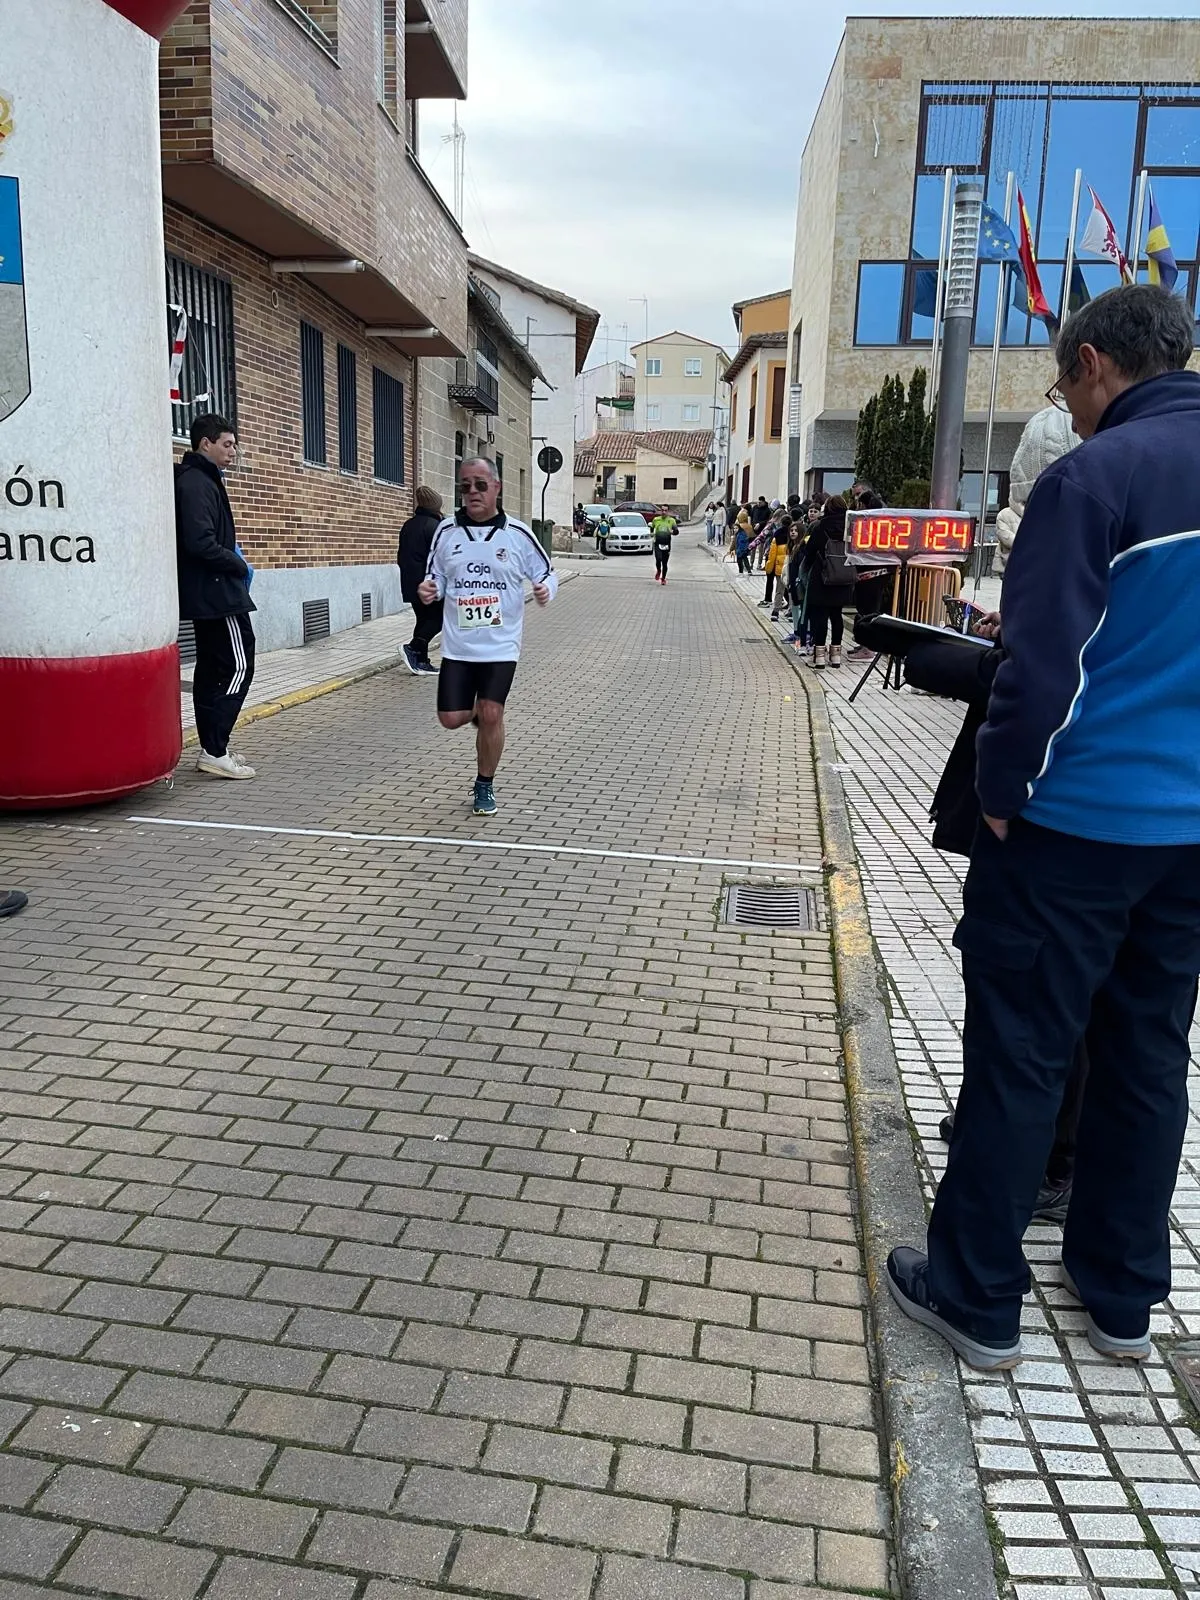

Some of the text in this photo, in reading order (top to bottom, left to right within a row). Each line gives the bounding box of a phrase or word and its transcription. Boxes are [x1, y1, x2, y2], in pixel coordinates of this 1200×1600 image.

[5, 464, 65, 508] ón
[0, 532, 96, 563] anca
[467, 562, 491, 576] Caja
[465, 606, 492, 620] 316
